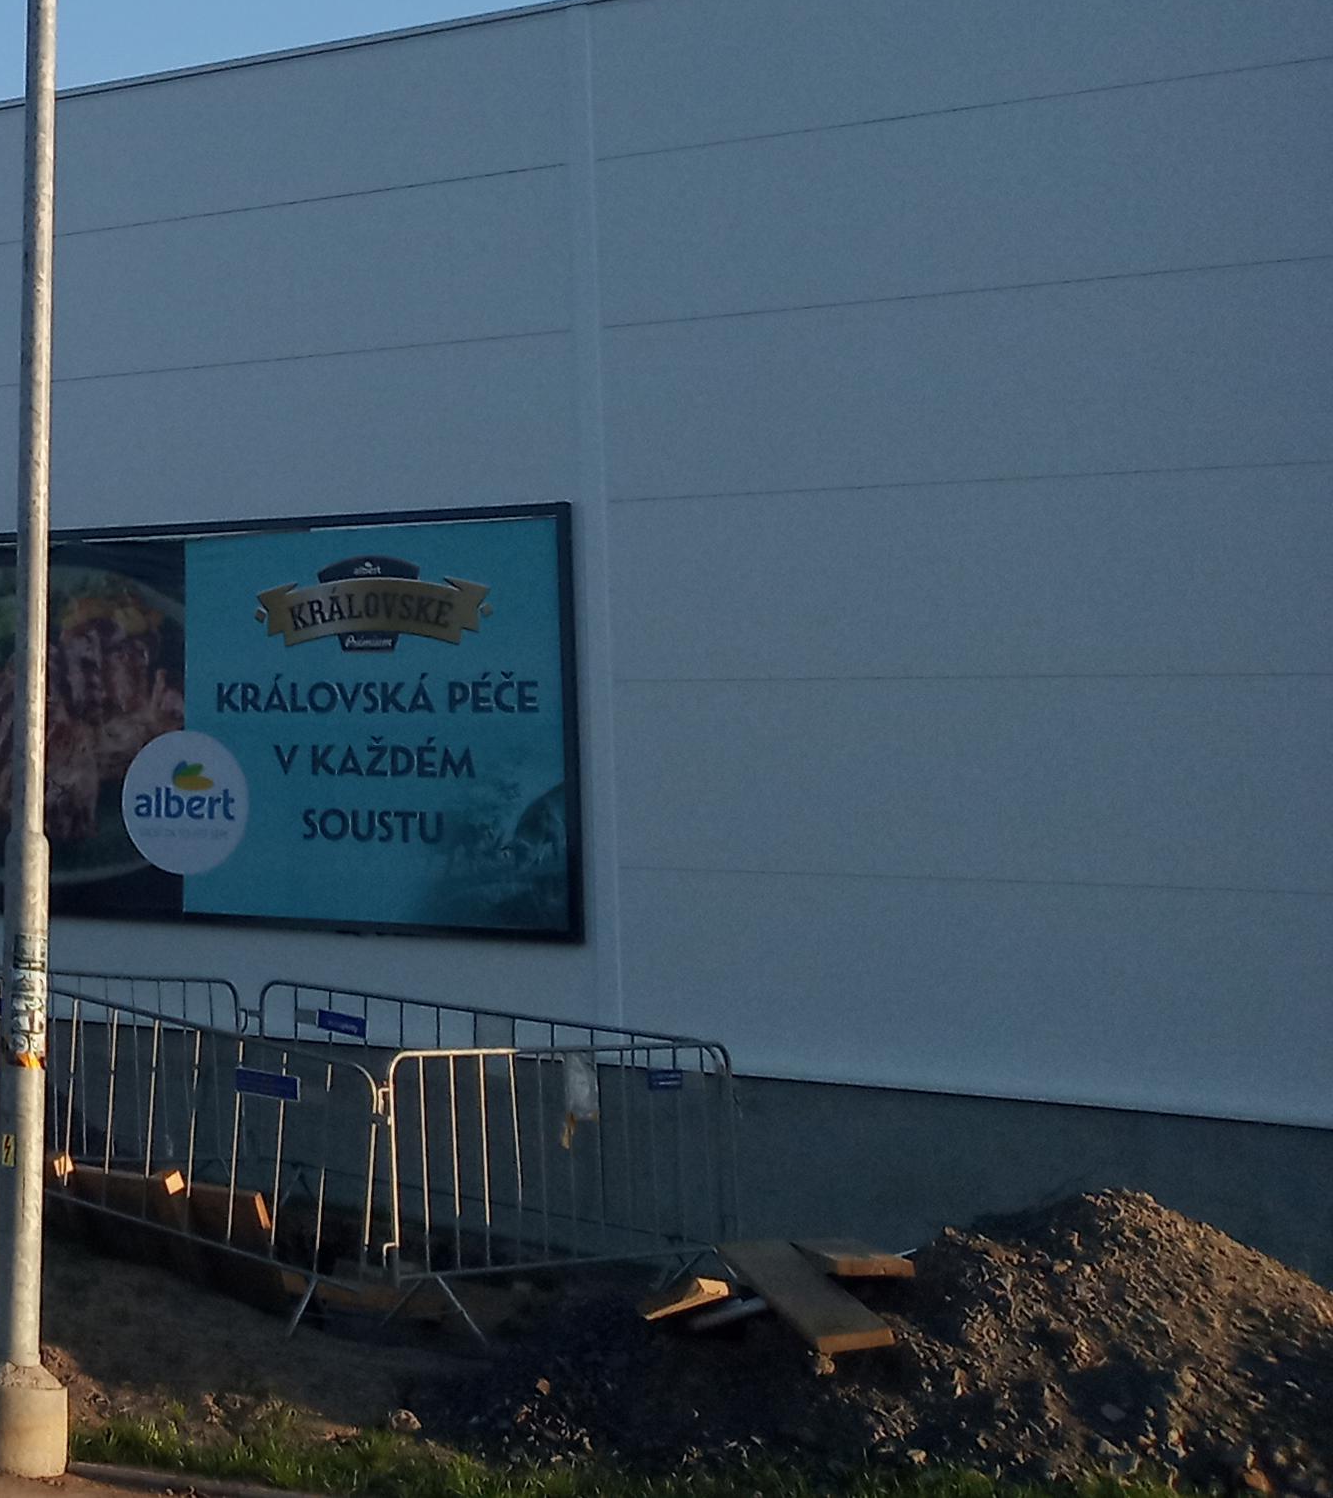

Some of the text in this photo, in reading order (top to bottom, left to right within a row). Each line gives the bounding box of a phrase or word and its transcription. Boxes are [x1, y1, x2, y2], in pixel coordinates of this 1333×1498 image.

[353, 565, 382, 576] albert
[288, 585, 454, 632] KRÁLOVSKÉ
[216, 671, 540, 714] KRÁLOVSKÁ PÉČE
[273, 735, 477, 779] V KAŽDÉM
[134, 786, 236, 820] albert
[302, 807, 445, 845] SOUSTU
